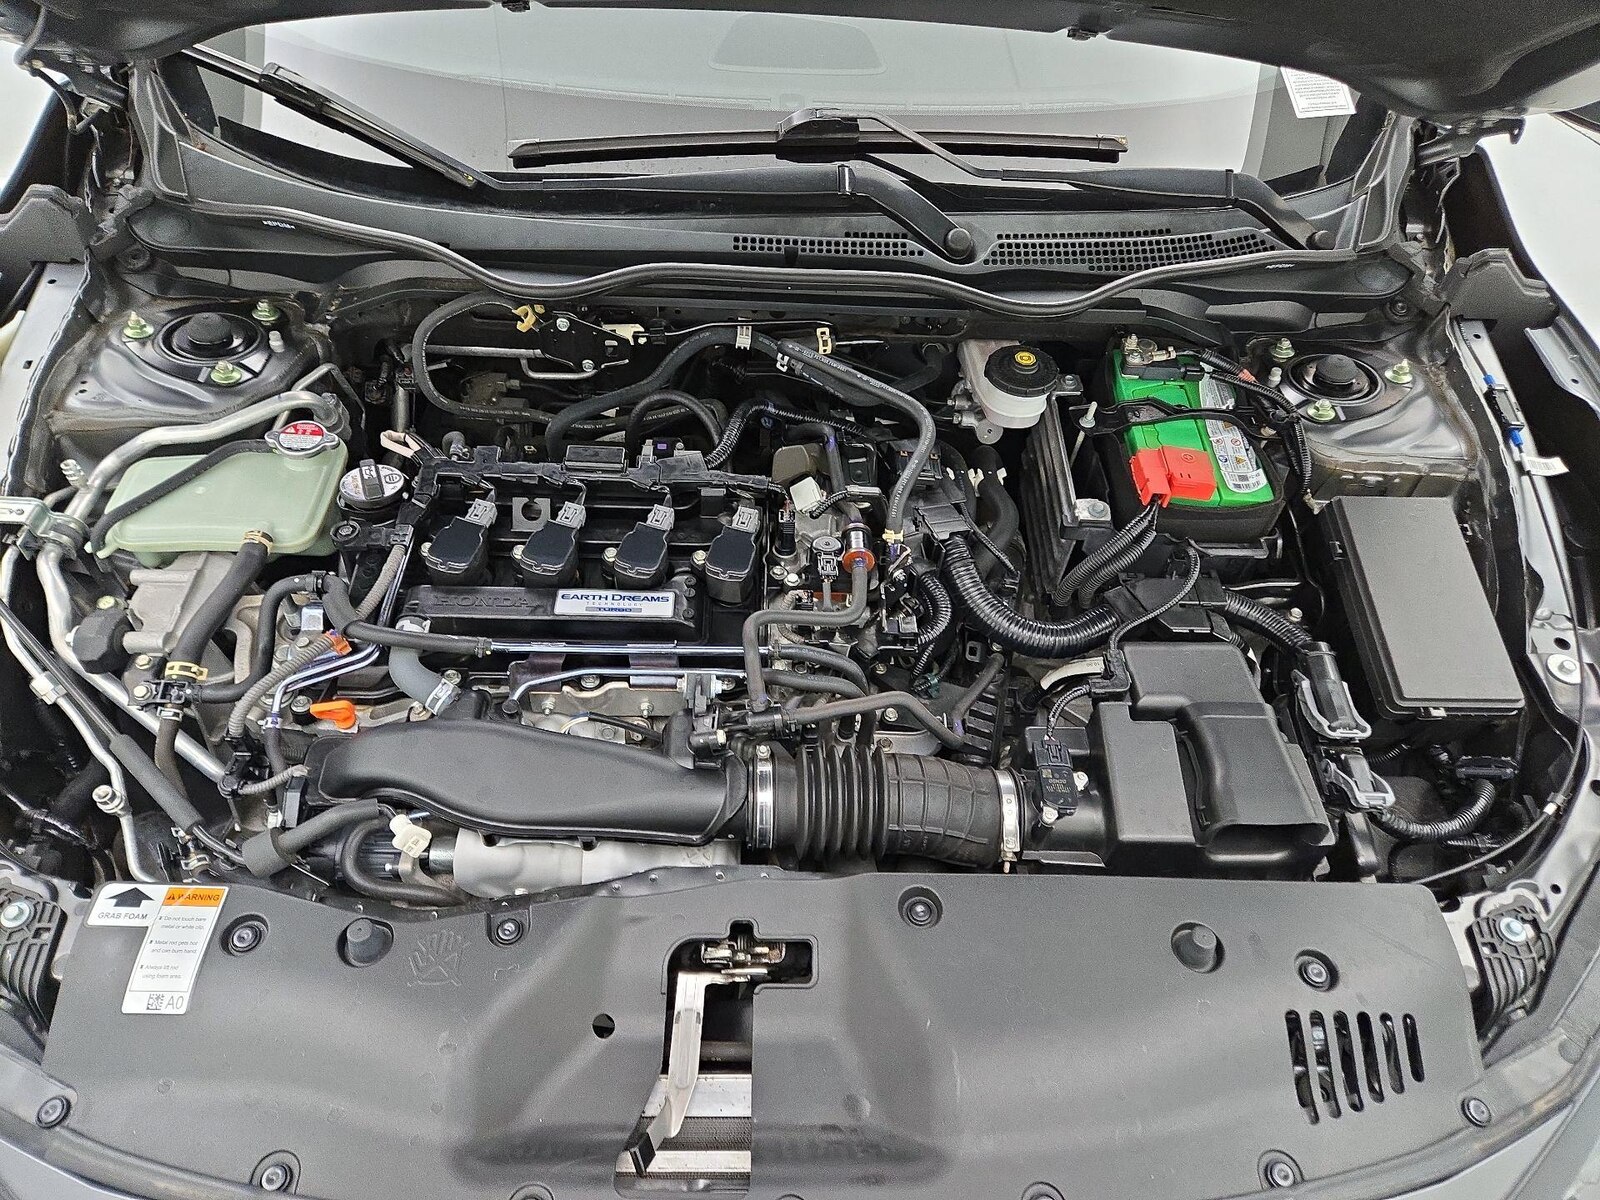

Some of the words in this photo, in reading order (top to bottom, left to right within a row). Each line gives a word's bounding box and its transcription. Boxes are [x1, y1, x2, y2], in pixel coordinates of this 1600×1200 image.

[612, 594, 669, 602] DREAMS
[98, 912, 122, 920] GRAB
[165, 995, 184, 1010] A0
